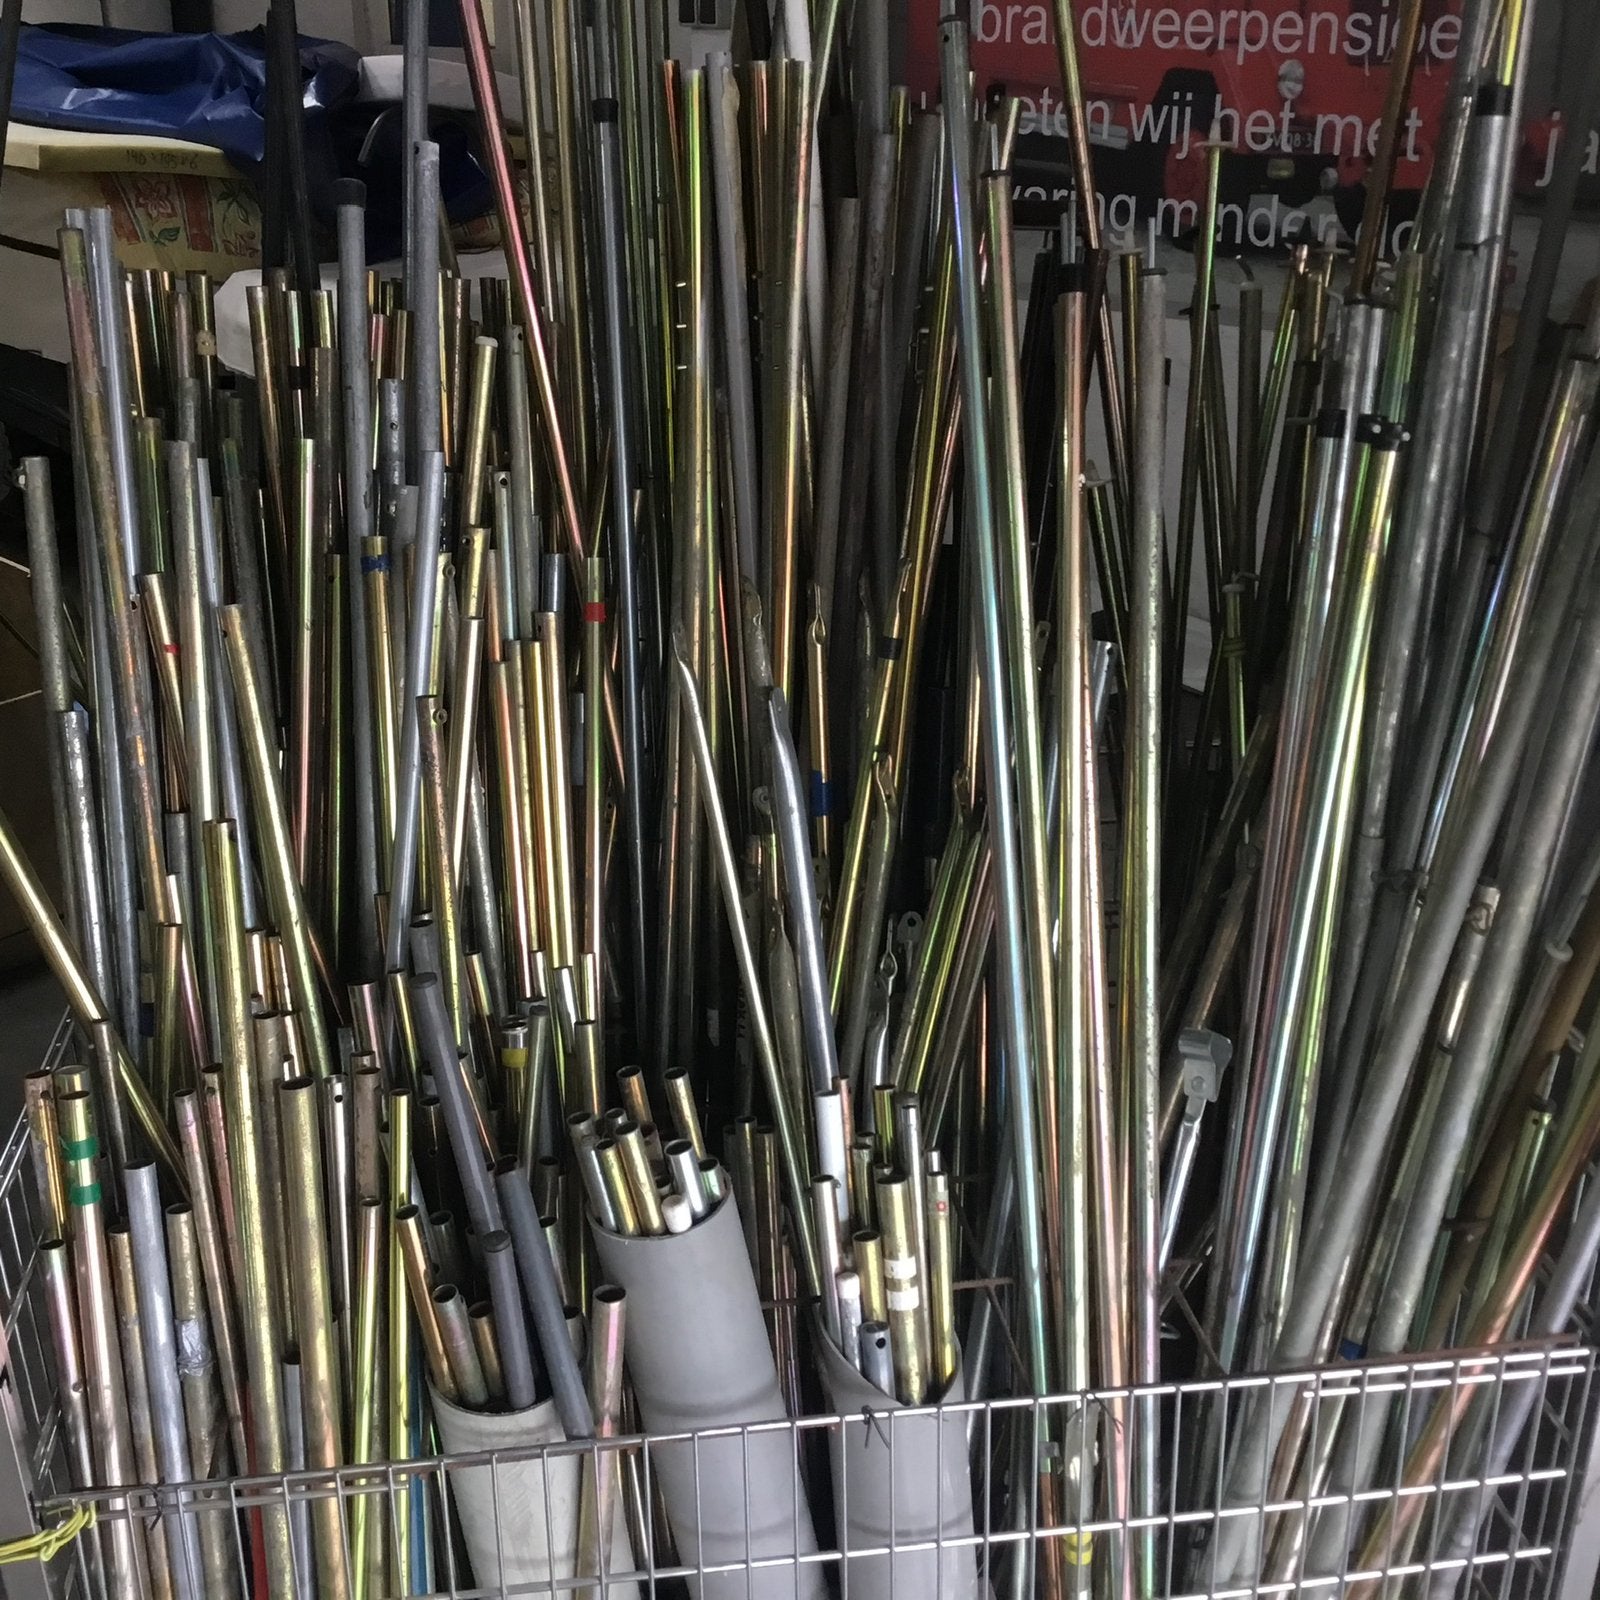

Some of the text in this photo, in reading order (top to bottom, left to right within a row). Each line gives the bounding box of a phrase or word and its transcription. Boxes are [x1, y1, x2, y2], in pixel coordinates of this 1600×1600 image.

[1128, 91, 1193, 160] wij
[1211, 93, 1296, 153] het
[1156, 194, 1338, 249] mnder
